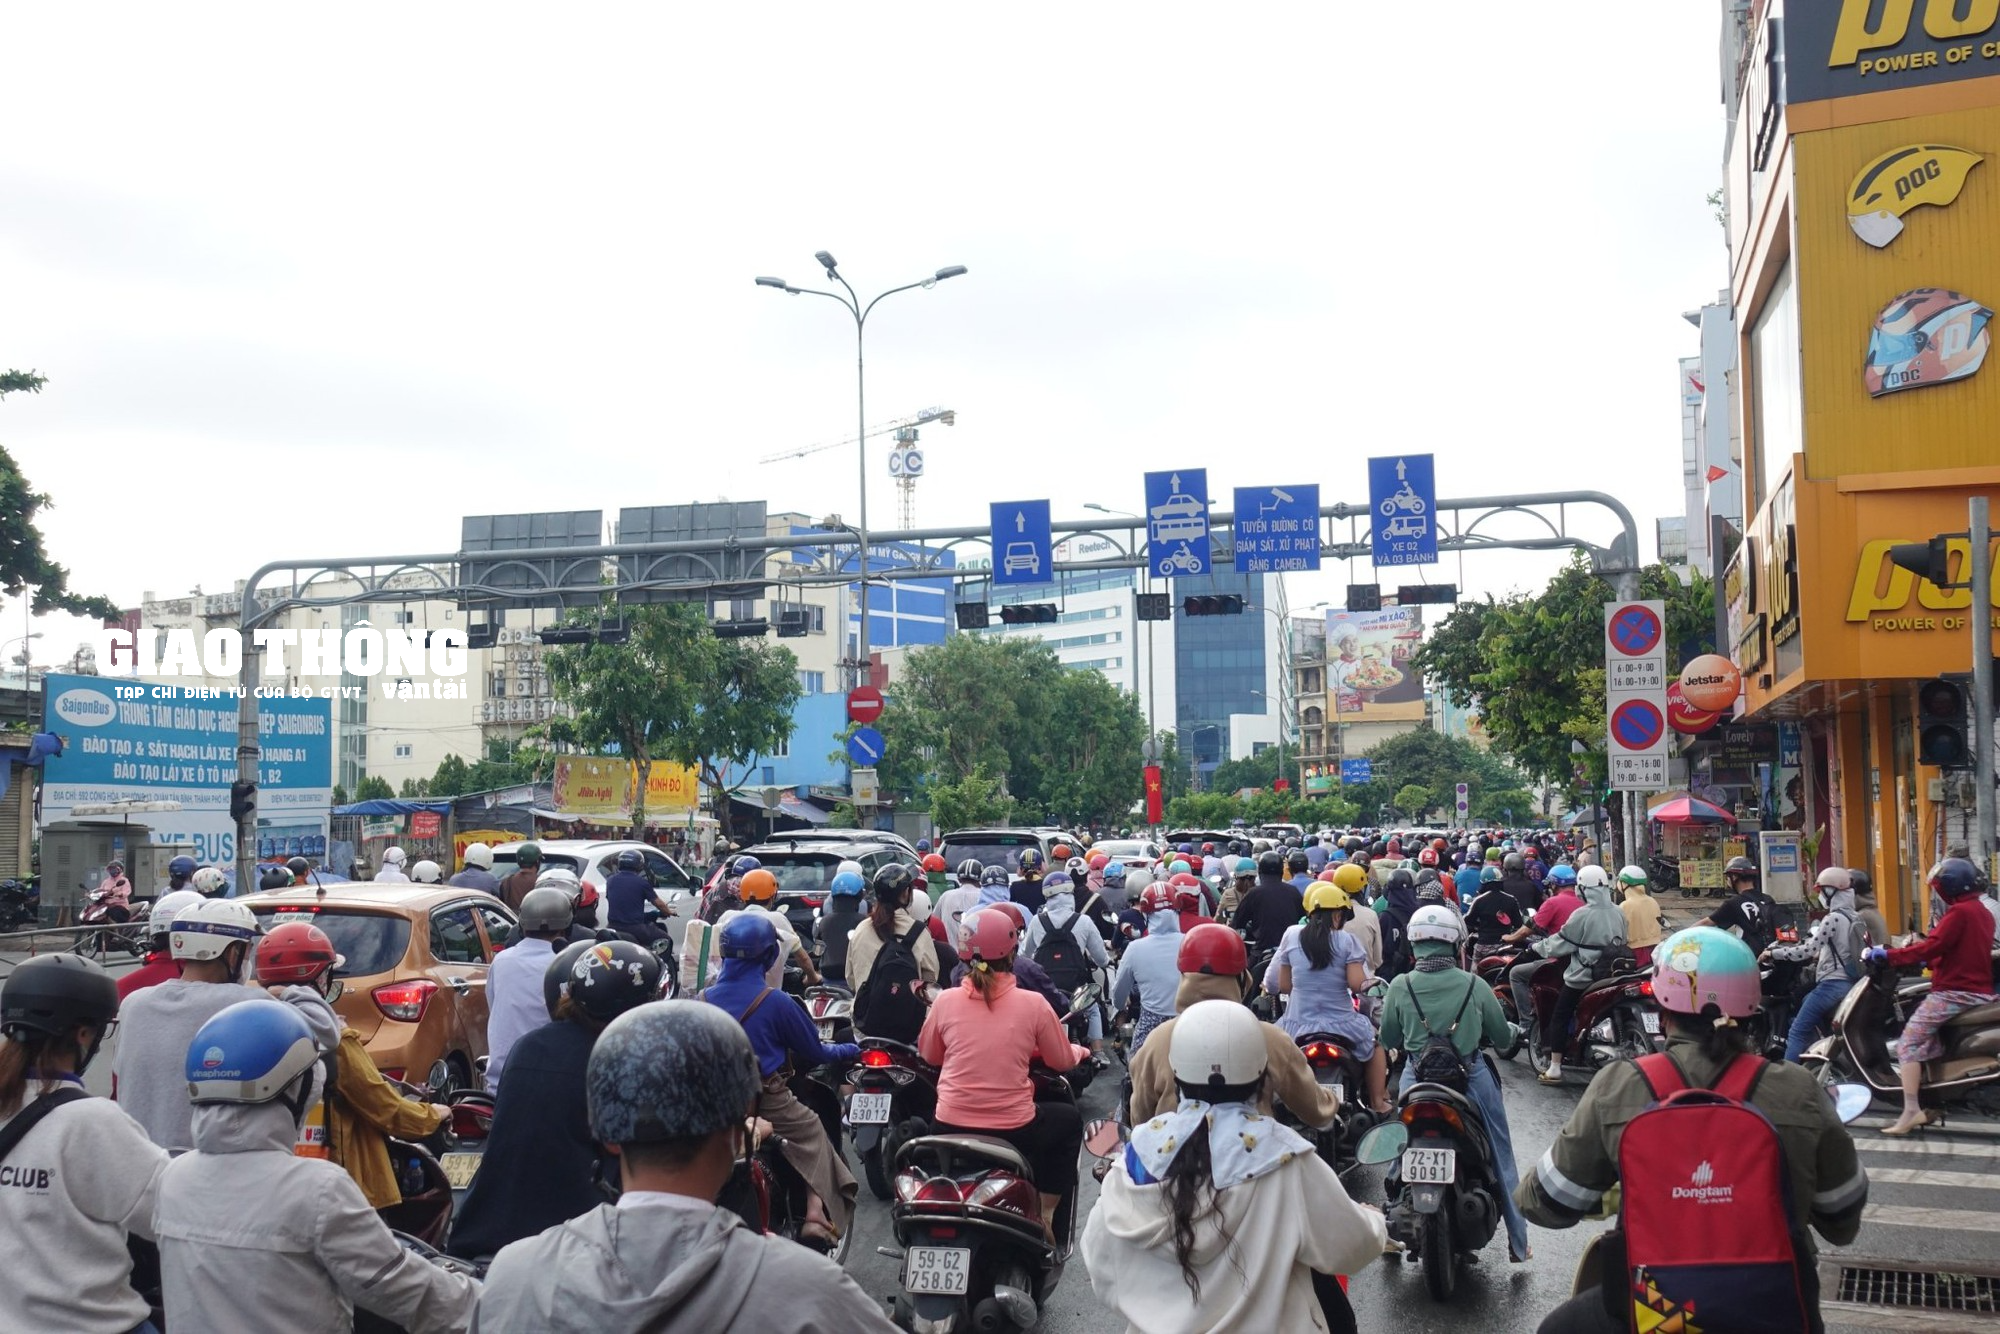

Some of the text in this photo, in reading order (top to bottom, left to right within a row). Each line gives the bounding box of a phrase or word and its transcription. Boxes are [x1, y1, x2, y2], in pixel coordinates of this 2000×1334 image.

[1860, 51, 1938, 76] POWER
[1946, 45, 1973, 63] OF
[1241, 516, 1314, 534] TUYẾN ĐƯỜNG CÓ
[1079, 541, 1111, 554] Reetech
[1236, 537, 1256, 553] GIÁM
[1294, 537, 1316, 553] PHẠT
[1392, 541, 1418, 552] XE 02
[1248, 554, 1308, 571] BẰNG CAMERA
[1377, 551, 1435, 564] VÀ 03 BÁNH
[1874, 617, 1965, 631] POWER OF
[1617, 663, 1654, 673] 6:00-9:00
[1614, 676, 1659, 687] 16:00-19:00
[1685, 675, 1725, 686] Jetstar
[62, 698, 110, 715] SaigonBus
[118, 701, 150, 726] TRUNG
[151, 701, 171, 728] TÂM
[174, 704, 196, 730] GIÁO
[198, 709, 216, 736] DỤC
[278, 714, 325, 735] SAIGONBUS
[1725, 729, 1754, 746] Lovely
[83, 735, 107, 754] ĐÀO
[110, 740, 131, 758] TẠO
[135, 741, 144, 755] &
[148, 740, 168, 758] SÁT
[169, 744, 197, 762] HẠCH
[200, 744, 216, 760] LÁI
[218, 747, 231, 761] XE
[266, 748, 293, 765] HẠNG
[295, 749, 306, 762] A1
[114, 760, 136, 779] ĐÀO
[140, 764, 159, 784] TẠO
[162, 763, 179, 782] LÁI
[182, 767, 194, 782] XE
[197, 765, 205, 783] Ô
[207, 765, 220, 783] TÔ
[1616, 760, 1632, 769] 9:00
[1641, 759, 1661, 769] 16:00
[268, 769, 281, 784] B2
[651, 776, 681, 793] KINH ĐÔ
[1617, 773, 1636, 783] 19:00
[1645, 773, 1661, 782] 6:00
[193, 832, 234, 863] BUS
[852, 1109, 887, 1121] 530.12
[1410, 1151, 1446, 1166] 72-X1
[1410, 1165, 1446, 1182] 9091
[1672, 1186, 1732, 1199] Dongtam
[918, 1251, 961, 1270] 59-G2
[910, 1271, 965, 1291] 758.62
